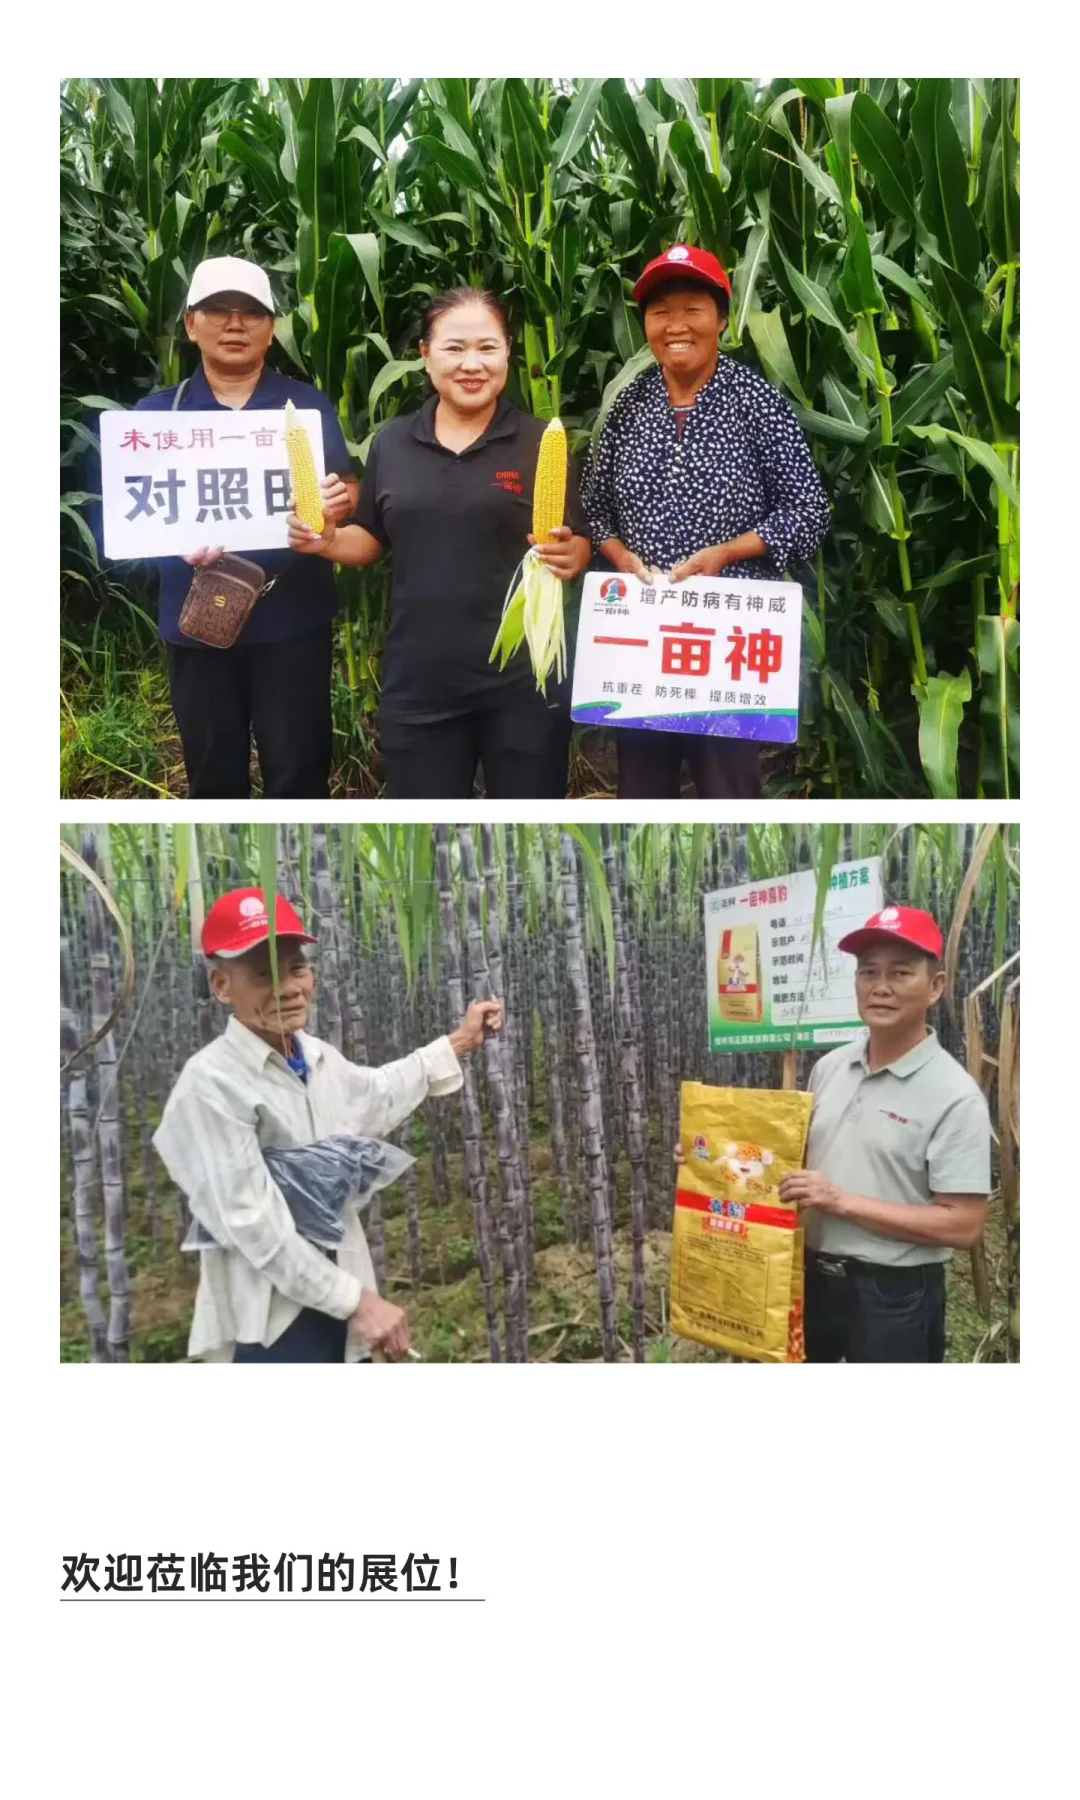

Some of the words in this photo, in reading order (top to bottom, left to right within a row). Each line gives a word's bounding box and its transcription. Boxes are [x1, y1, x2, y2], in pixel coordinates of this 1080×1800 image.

[119, 427, 286, 451] 未使用一亩
[640, 588, 787, 613] 增产防病有神威
[593, 622, 783, 684] 一亩神
[602, 681, 643, 695] 抗重茬
[709, 689, 767, 706] 提质增效
[770, 917, 786, 929] 电话
[772, 953, 804, 966] 示范时间
[772, 974, 788, 985] 地址
